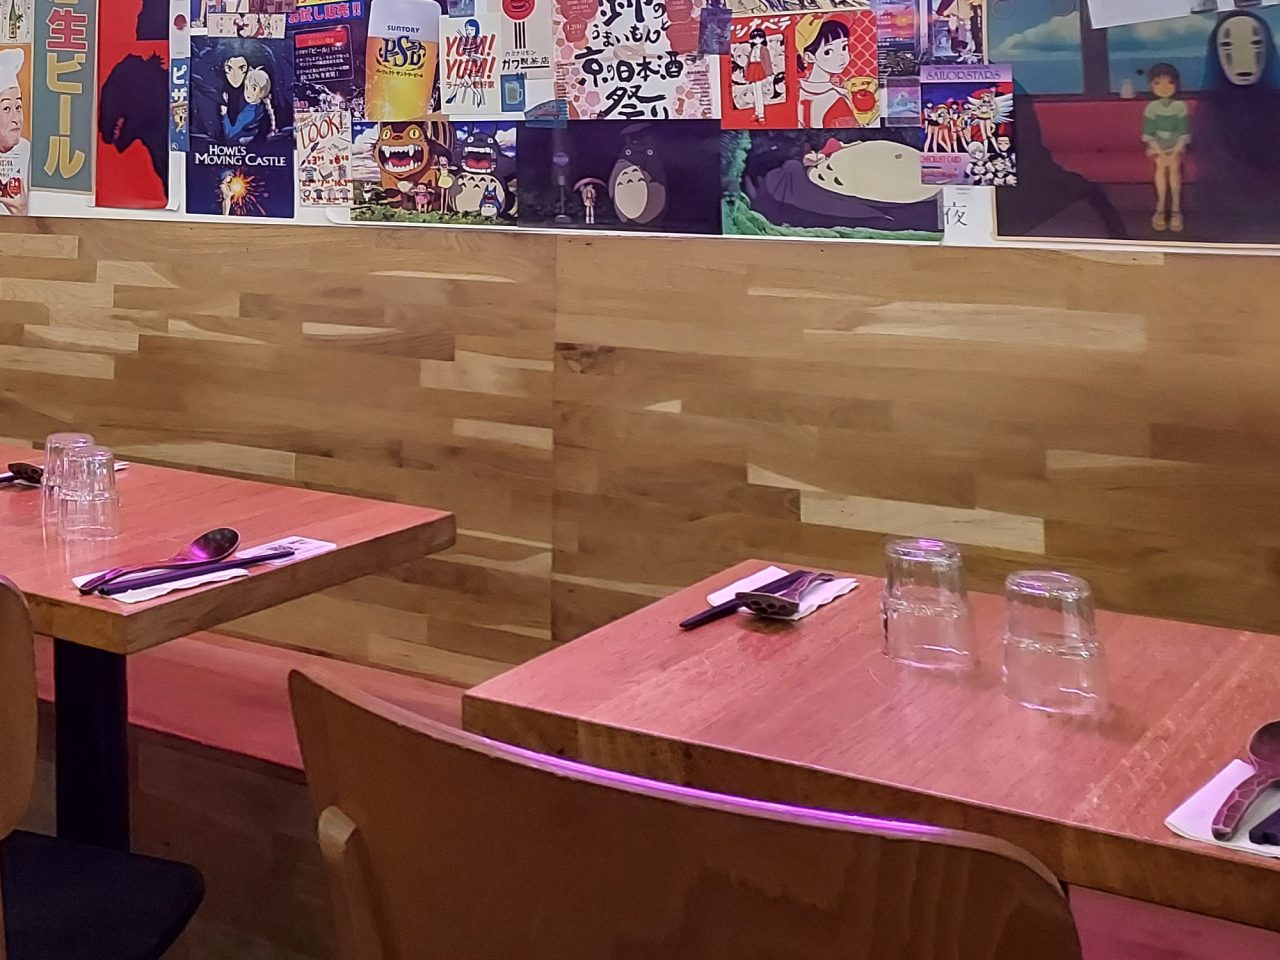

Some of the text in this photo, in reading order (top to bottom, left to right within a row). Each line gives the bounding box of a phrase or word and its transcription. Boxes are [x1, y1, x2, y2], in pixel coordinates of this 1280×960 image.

[171, 65, 188, 104] ピザ
[574, 46, 684, 87] 京の日本酒
[42, 7, 89, 179] 生ビール
[209, 144, 247, 156] HOWL'S
[299, 112, 345, 150] LOOK!
[194, 152, 287, 167] MOVING CASTLE
